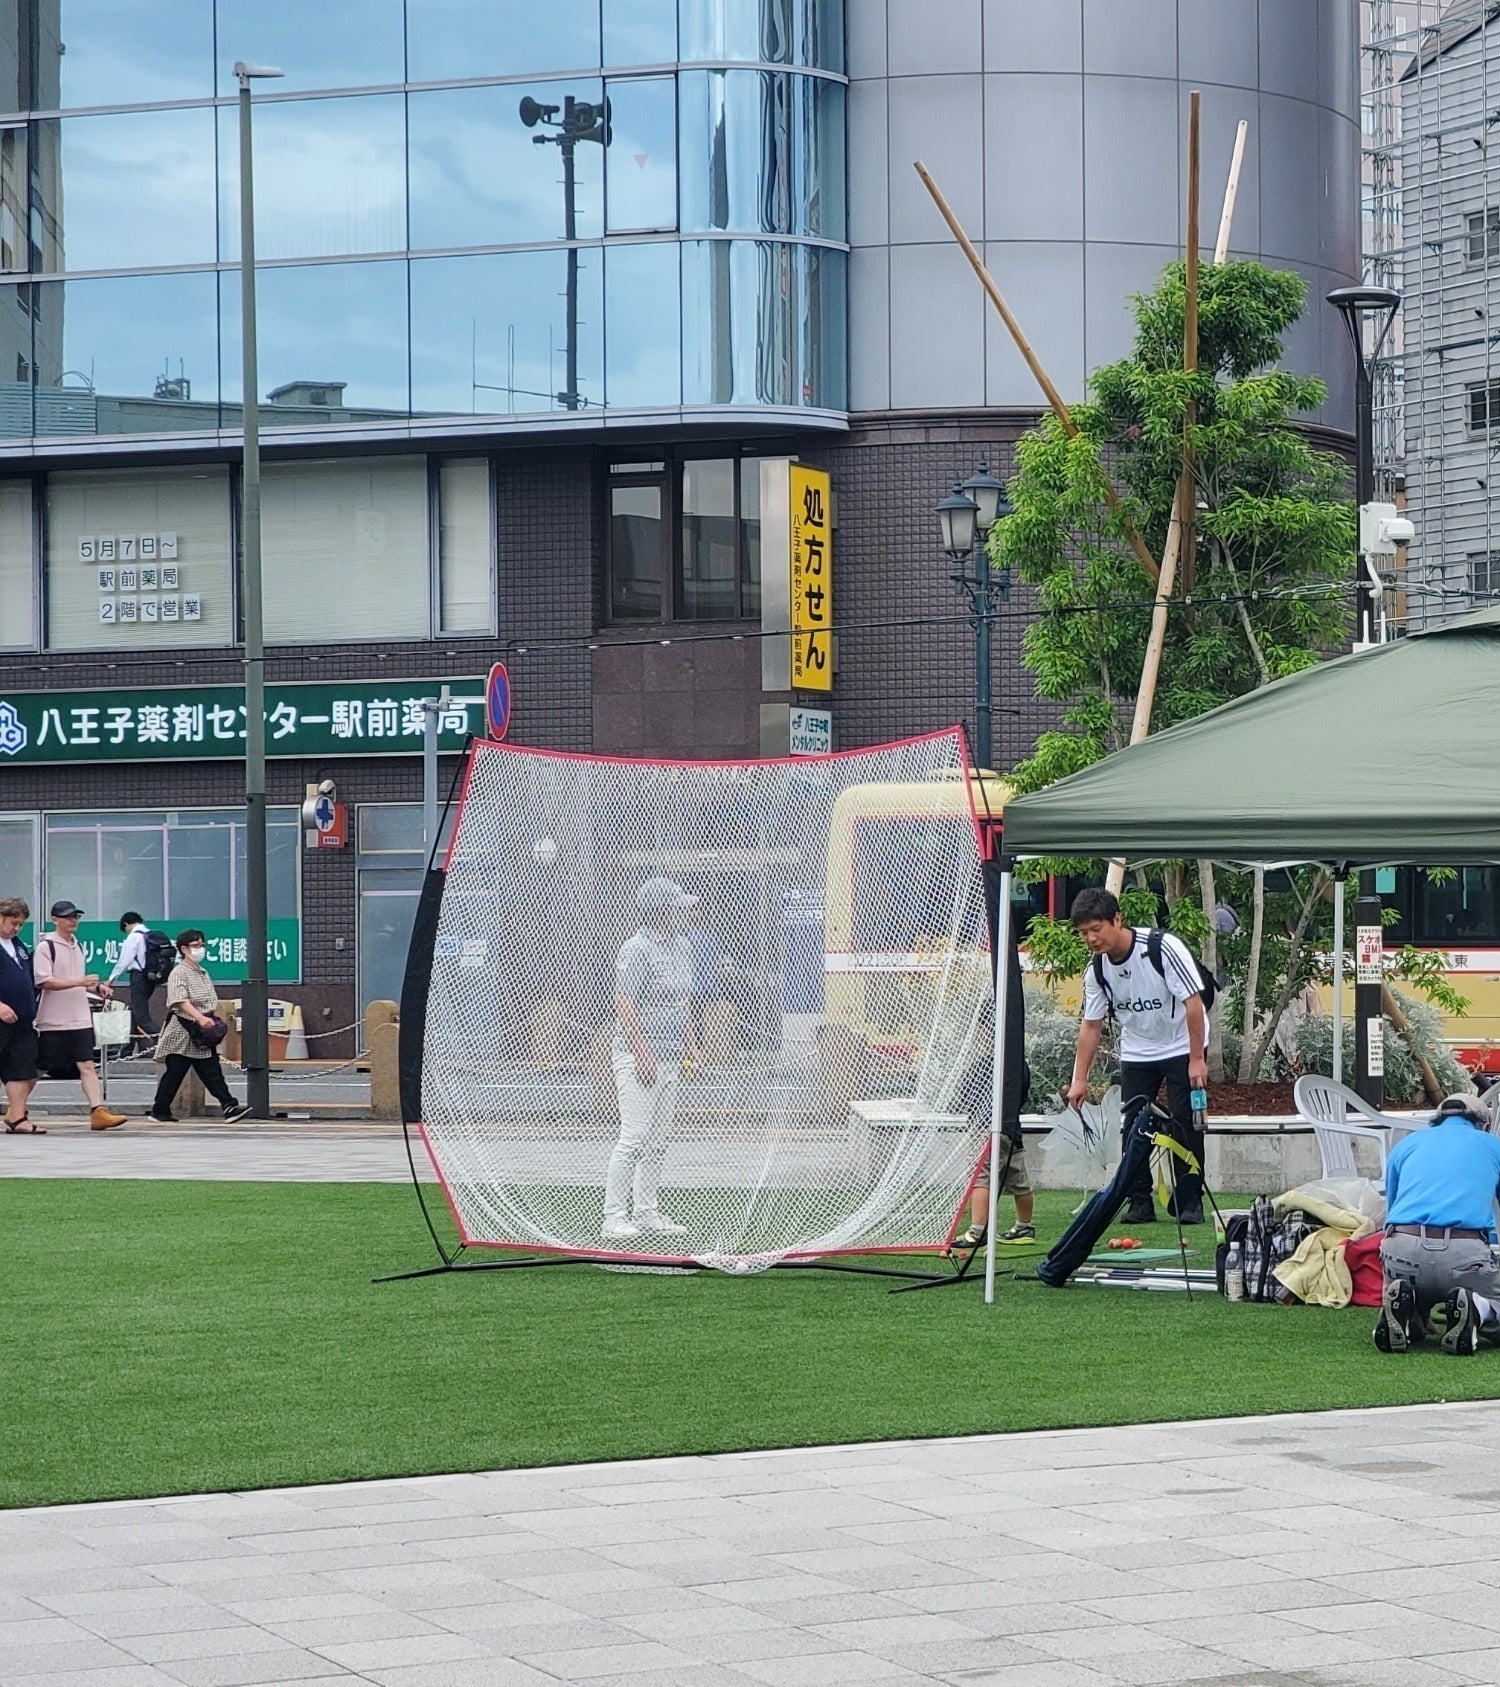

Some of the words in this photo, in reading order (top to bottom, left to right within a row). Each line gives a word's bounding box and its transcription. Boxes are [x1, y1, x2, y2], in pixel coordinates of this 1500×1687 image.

[100, 568, 177, 588] 駅前薬局
[803, 485, 825, 670] 処方せん
[101, 600, 199, 619] 2階で営業
